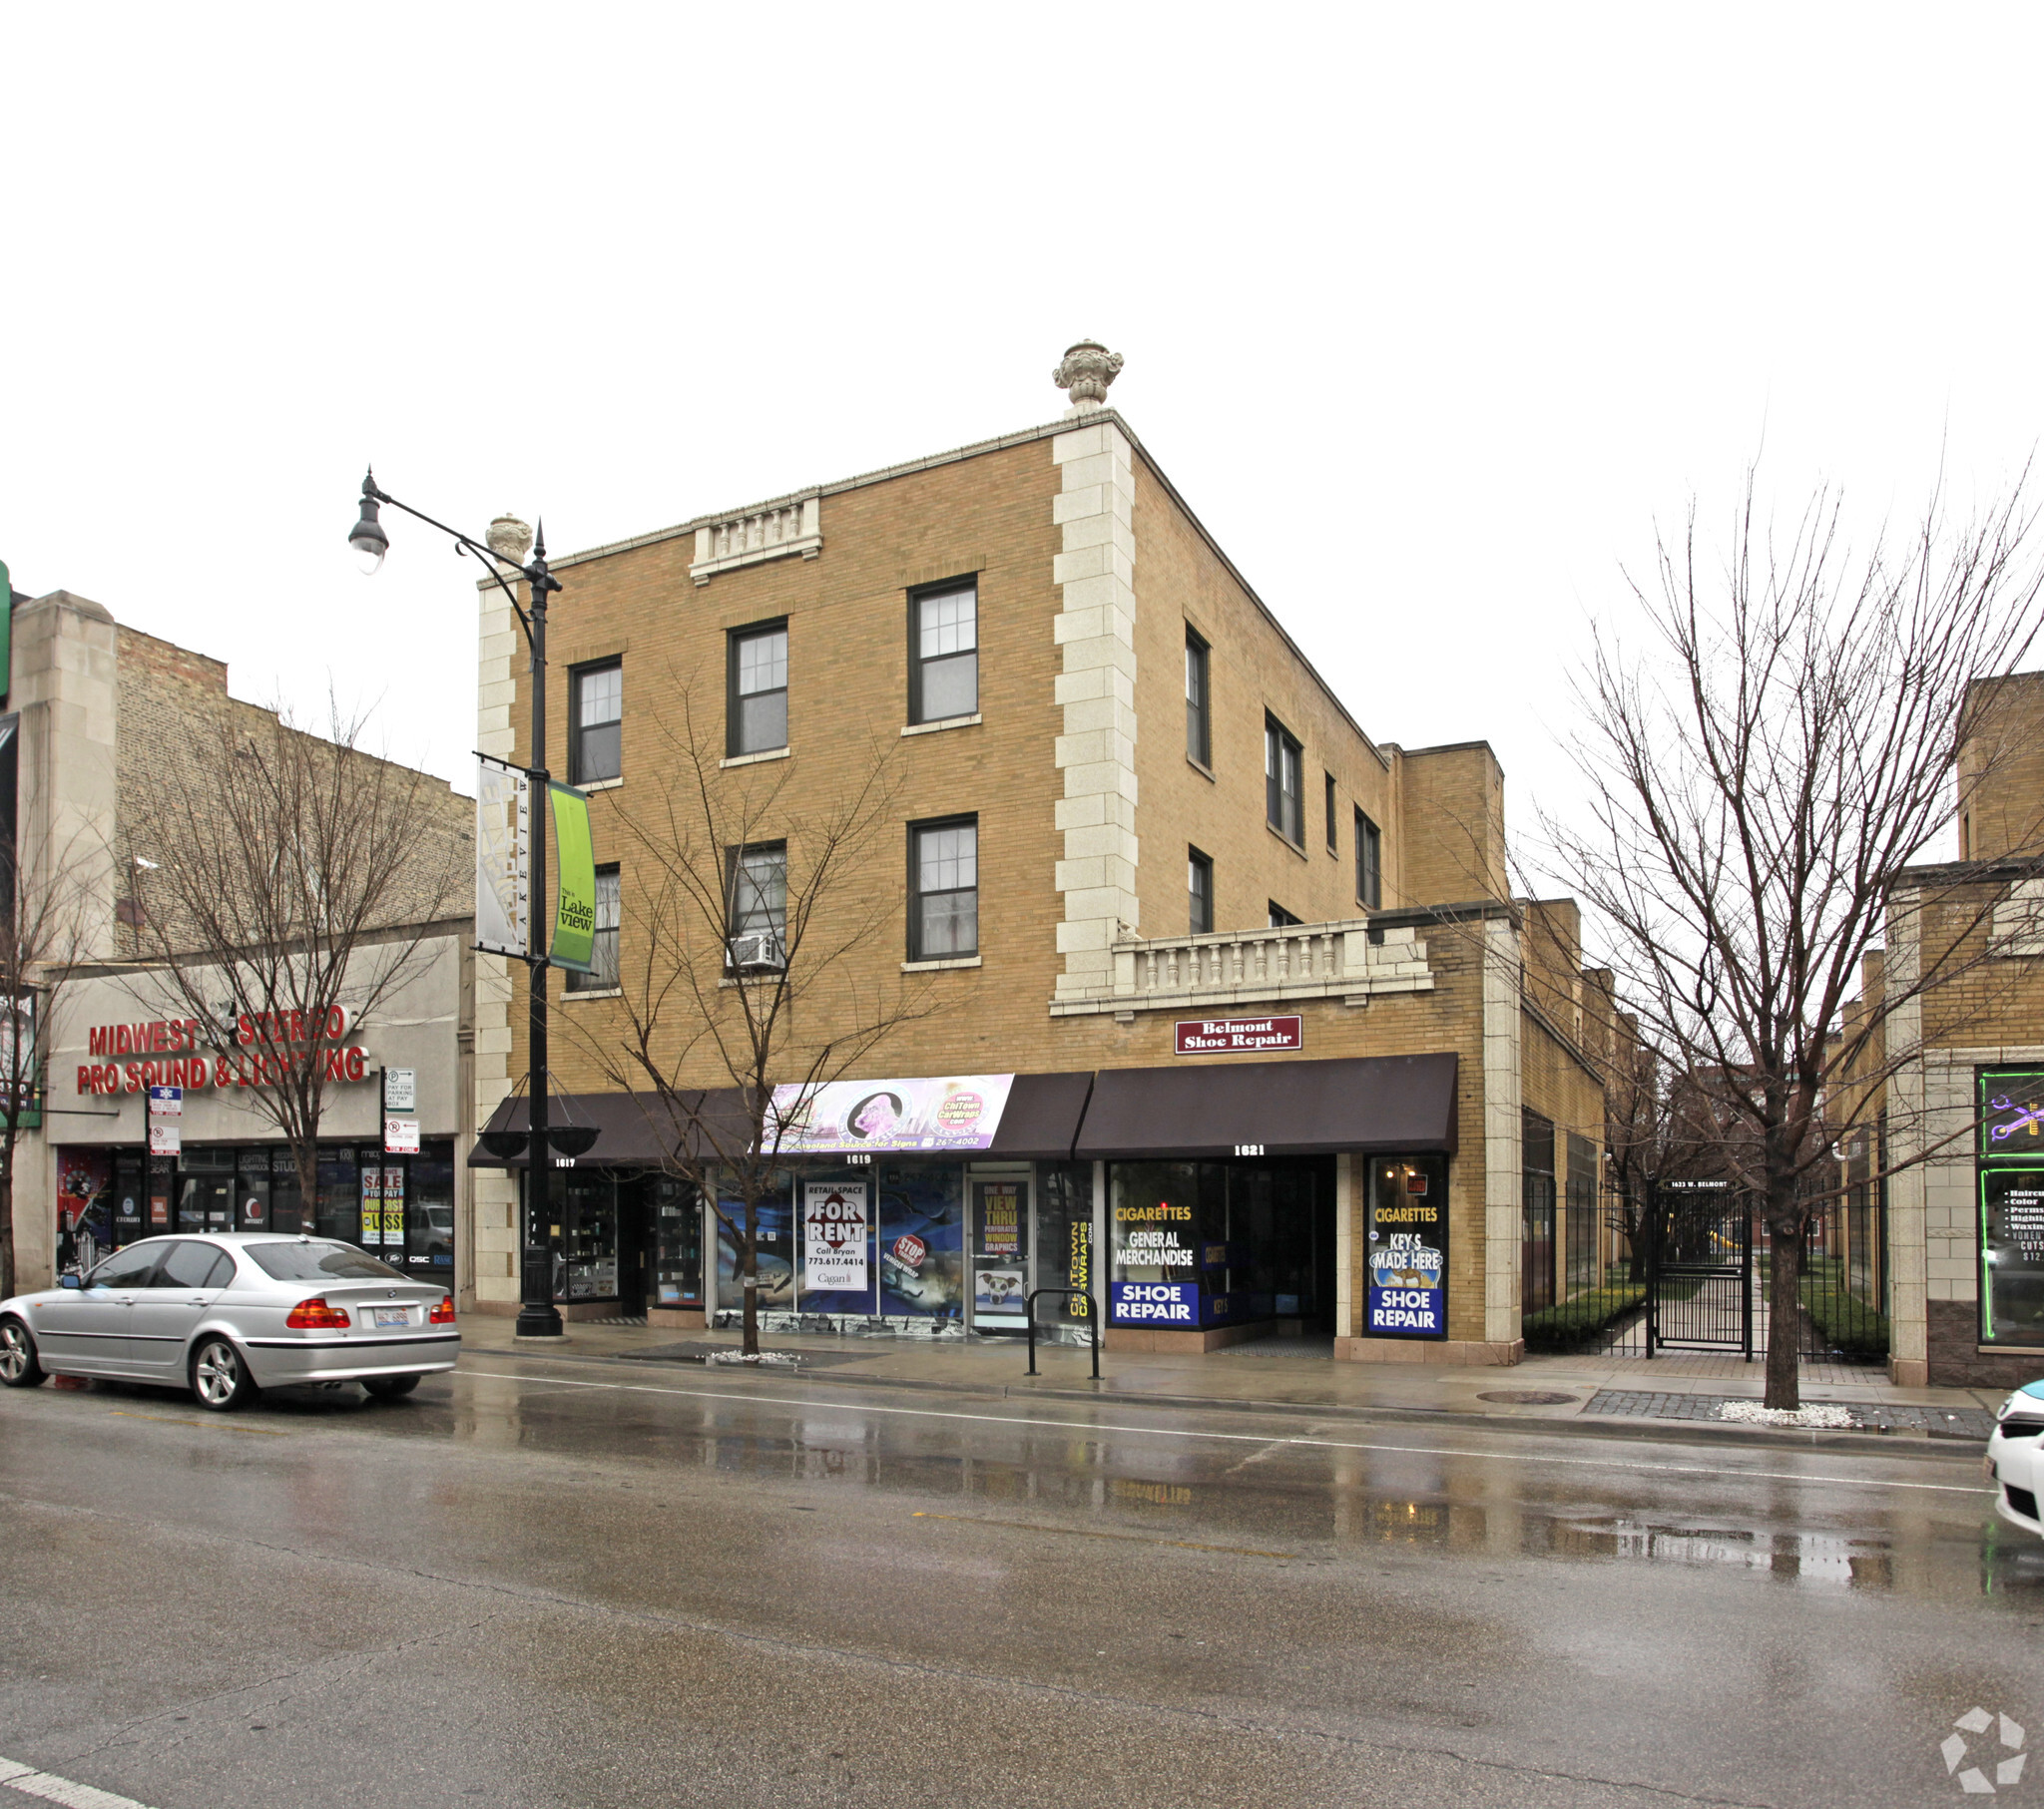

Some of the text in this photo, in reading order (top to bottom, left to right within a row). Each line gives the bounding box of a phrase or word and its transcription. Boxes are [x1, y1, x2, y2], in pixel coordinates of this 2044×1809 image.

[519, 781, 529, 947] LAKEVIEW
[561, 895, 593, 919] Lake
[561, 912, 593, 931] view
[89, 1005, 344, 1057] MIDWEST STEREO
[1202, 1020, 1274, 1035] Belmont
[1185, 1032, 1292, 1049] Shoe Repair
[78, 1063, 119, 1095] PRO
[125, 1058, 207, 1094] SOUND
[215, 1056, 232, 1088] &
[943, 1102, 981, 1111] ChiTown
[891, 1139, 917, 1149] Signs
[935, 1137, 980, 1146] 267-4002
[1235, 1144, 1265, 1155] 1621
[272, 1160, 297, 1172] STUD
[556, 1158, 575, 1167] 1617
[846, 1154, 871, 1164] 1619
[364, 1174, 401, 1189] SALE
[984, 1185, 1017, 1194] ONE WAY
[364, 1198, 403, 1211] OUR OST
[814, 1201, 857, 1220] FOR
[984, 1195, 1017, 1210] VIEW
[372, 1213, 404, 1230] LSS!
[984, 1211, 1018, 1225] THRU
[1115, 1206, 1192, 1221] CIGARETTES
[1374, 1206, 1438, 1223] CIGARETTES
[808, 1222, 864, 1242] RENT
[984, 1233, 1018, 1242] WINDOW
[1129, 1231, 1180, 1248] GENERAL
[833, 1247, 855, 1256] Bryan
[898, 1237, 923, 1259] STOP
[984, 1242, 1018, 1251] GRAPHICS
[2020, 1240, 2044, 1250] CUTS
[808, 1257, 863, 1266] 773.617.4414
[883, 1252, 919, 1278] VEHICLE WRAP
[1116, 1249, 1194, 1266] MERCHANDISE
[1374, 1251, 1440, 1270] MADE HERE
[1079, 1221, 1088, 1317] CARWRAPS
[817, 1272, 845, 1286] Cagan
[1122, 1284, 1182, 1302] SHOE
[1381, 1290, 1430, 1309] SHOE
[1116, 1302, 1191, 1320] REPAIR
[1373, 1309, 1435, 1328] REPAIR
